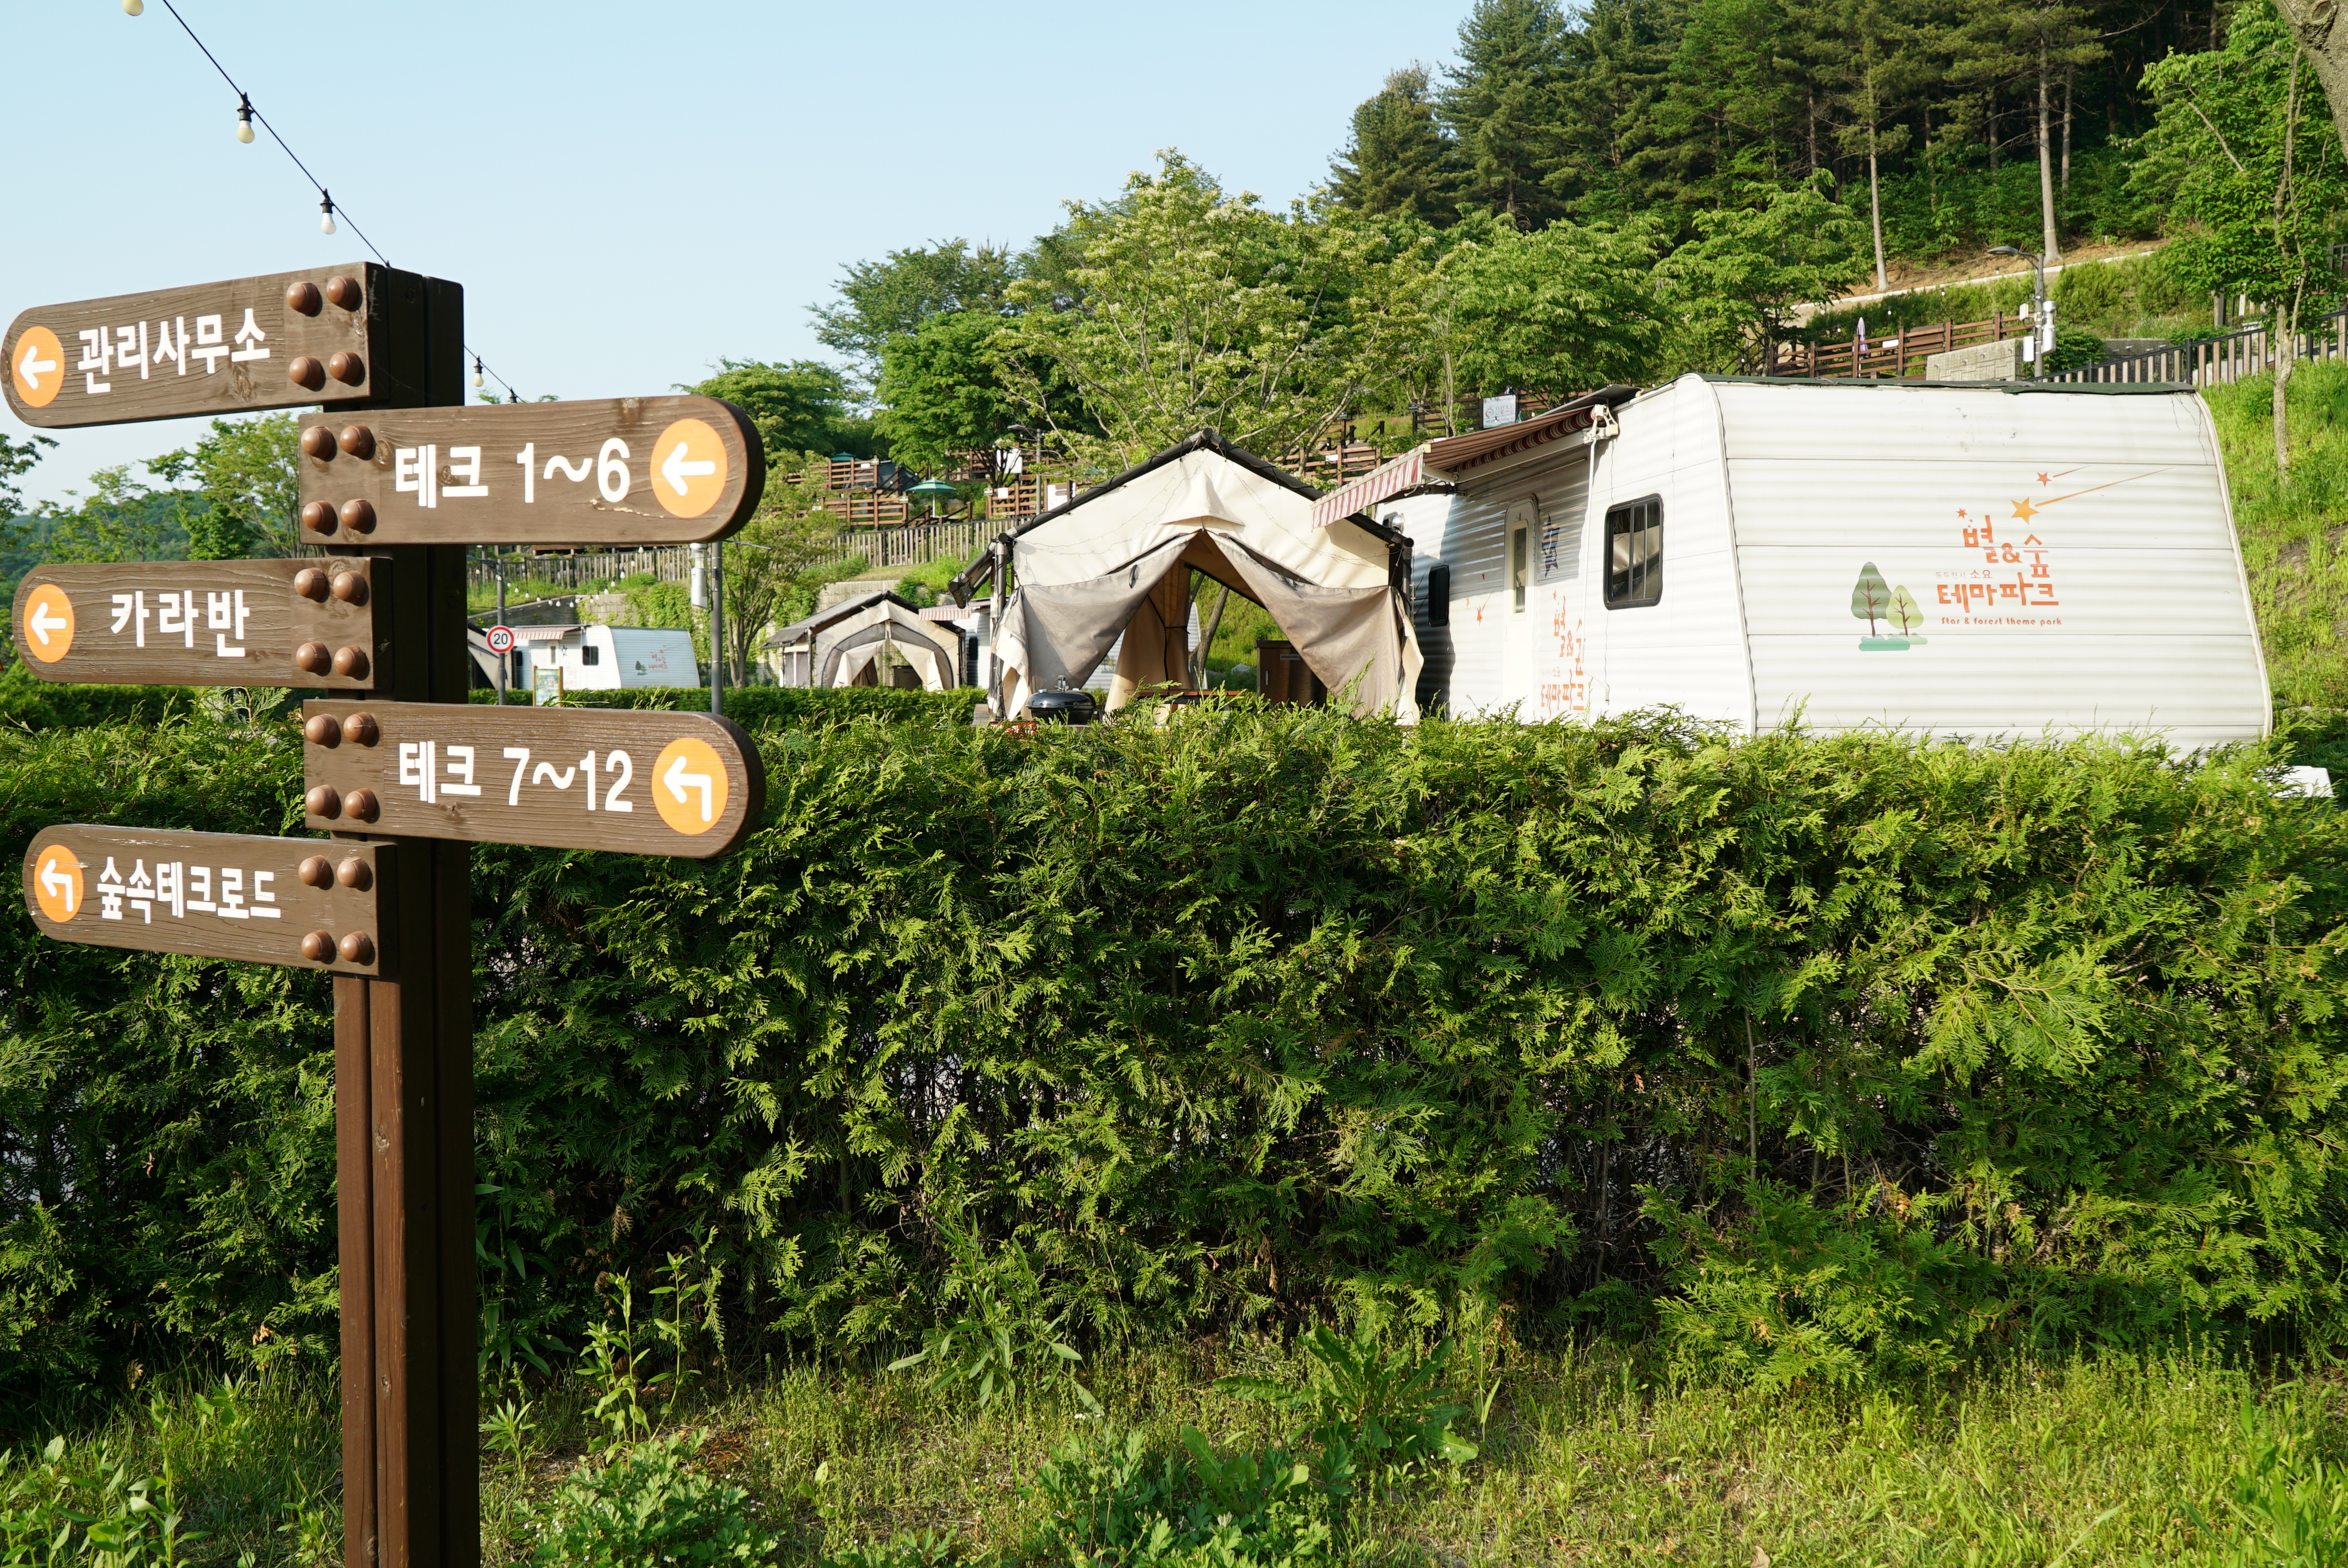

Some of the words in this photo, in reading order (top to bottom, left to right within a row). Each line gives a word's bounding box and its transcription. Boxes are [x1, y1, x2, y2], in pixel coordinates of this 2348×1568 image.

[77, 308, 271, 395] 관리사무소
[395, 444, 489, 509] 테크
[516, 437, 631, 504] 1~6
[1937, 572, 2059, 613] 테마파크
[1970, 569, 1993, 579] 소요
[111, 589, 250, 658] 카라반
[493, 633, 508, 645] 20
[1941, 617, 1960, 625] Star
[1973, 616, 2002, 625] forest
[2006, 617, 2036, 626] theme
[2040, 617, 2063, 627] park
[1541, 668, 1585, 719] 테마파크
[399, 741, 481, 804] 테크
[503, 747, 633, 813] 7~12
[96, 856, 281, 925] 숲속테크로드
